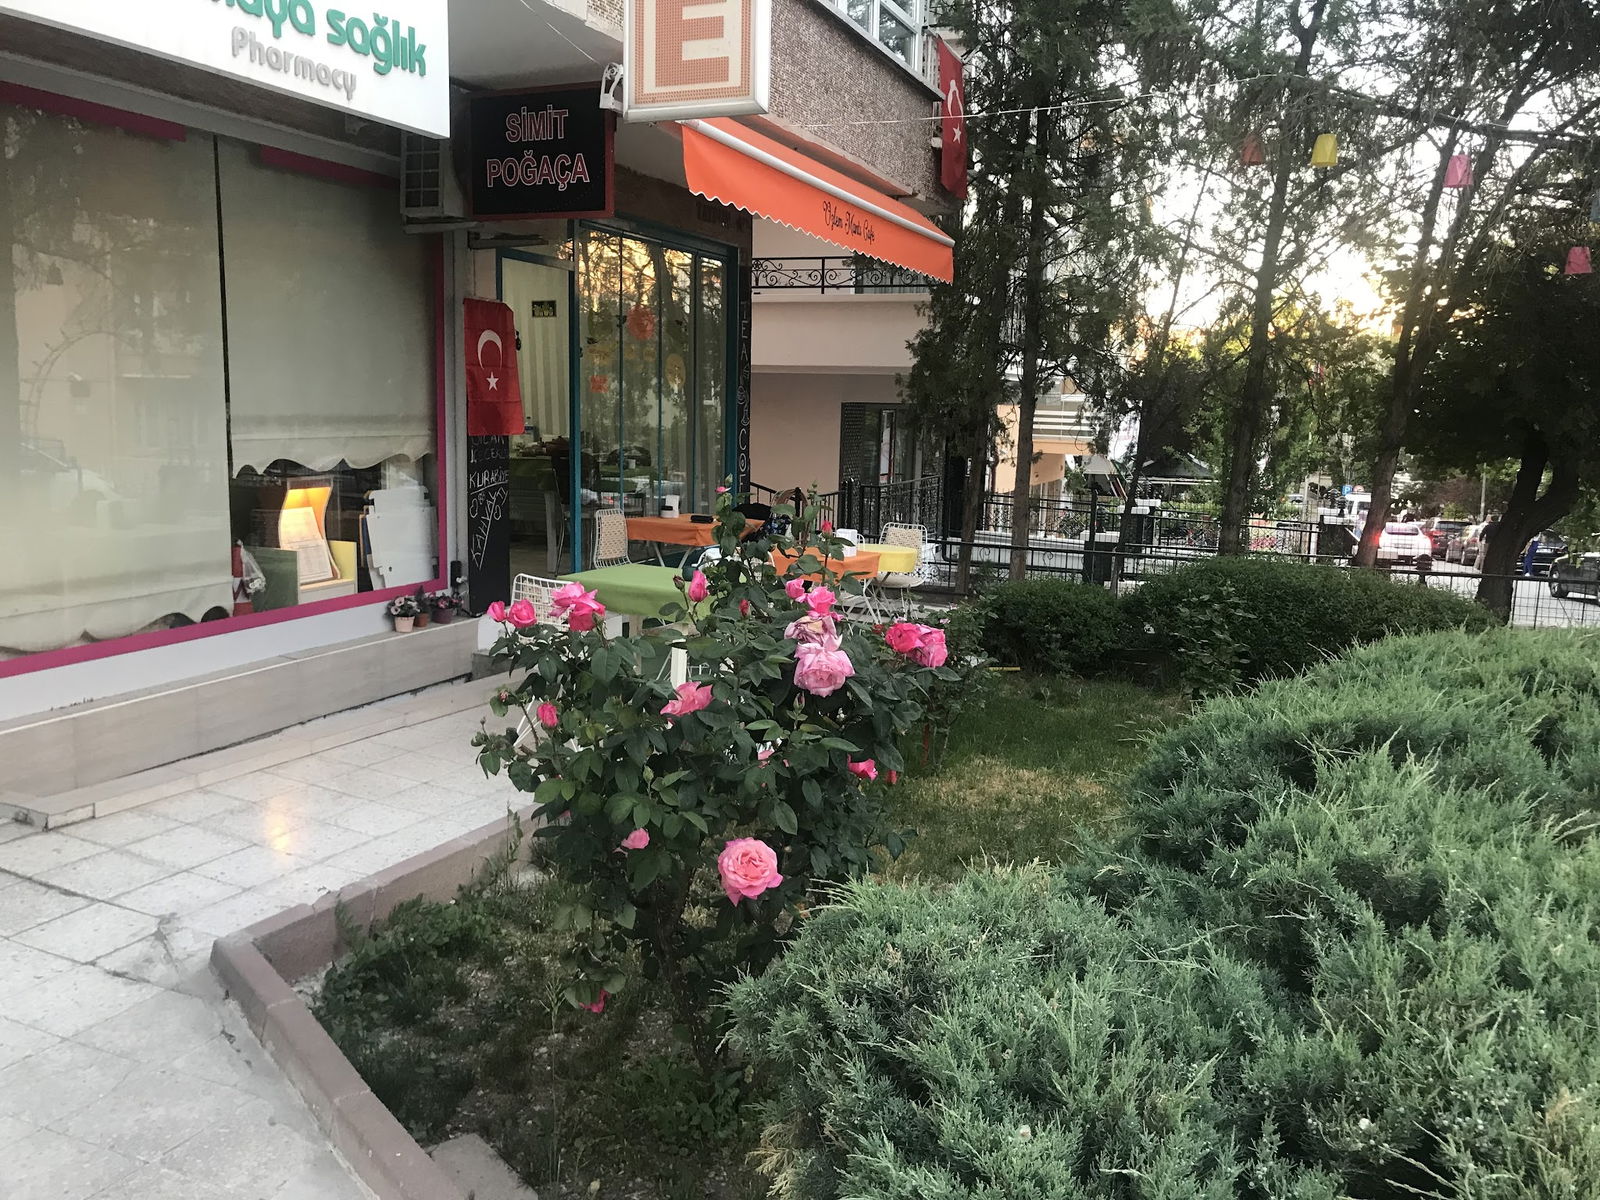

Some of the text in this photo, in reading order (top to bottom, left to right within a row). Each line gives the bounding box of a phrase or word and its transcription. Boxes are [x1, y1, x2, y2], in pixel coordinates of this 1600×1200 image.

[231, 26, 357, 101] Pharmacy
[326, 8, 427, 77] sağlık
[655, 0, 729, 87] E
[505, 104, 569, 143] SİMİT
[486, 150, 590, 192] POĞAÇA
